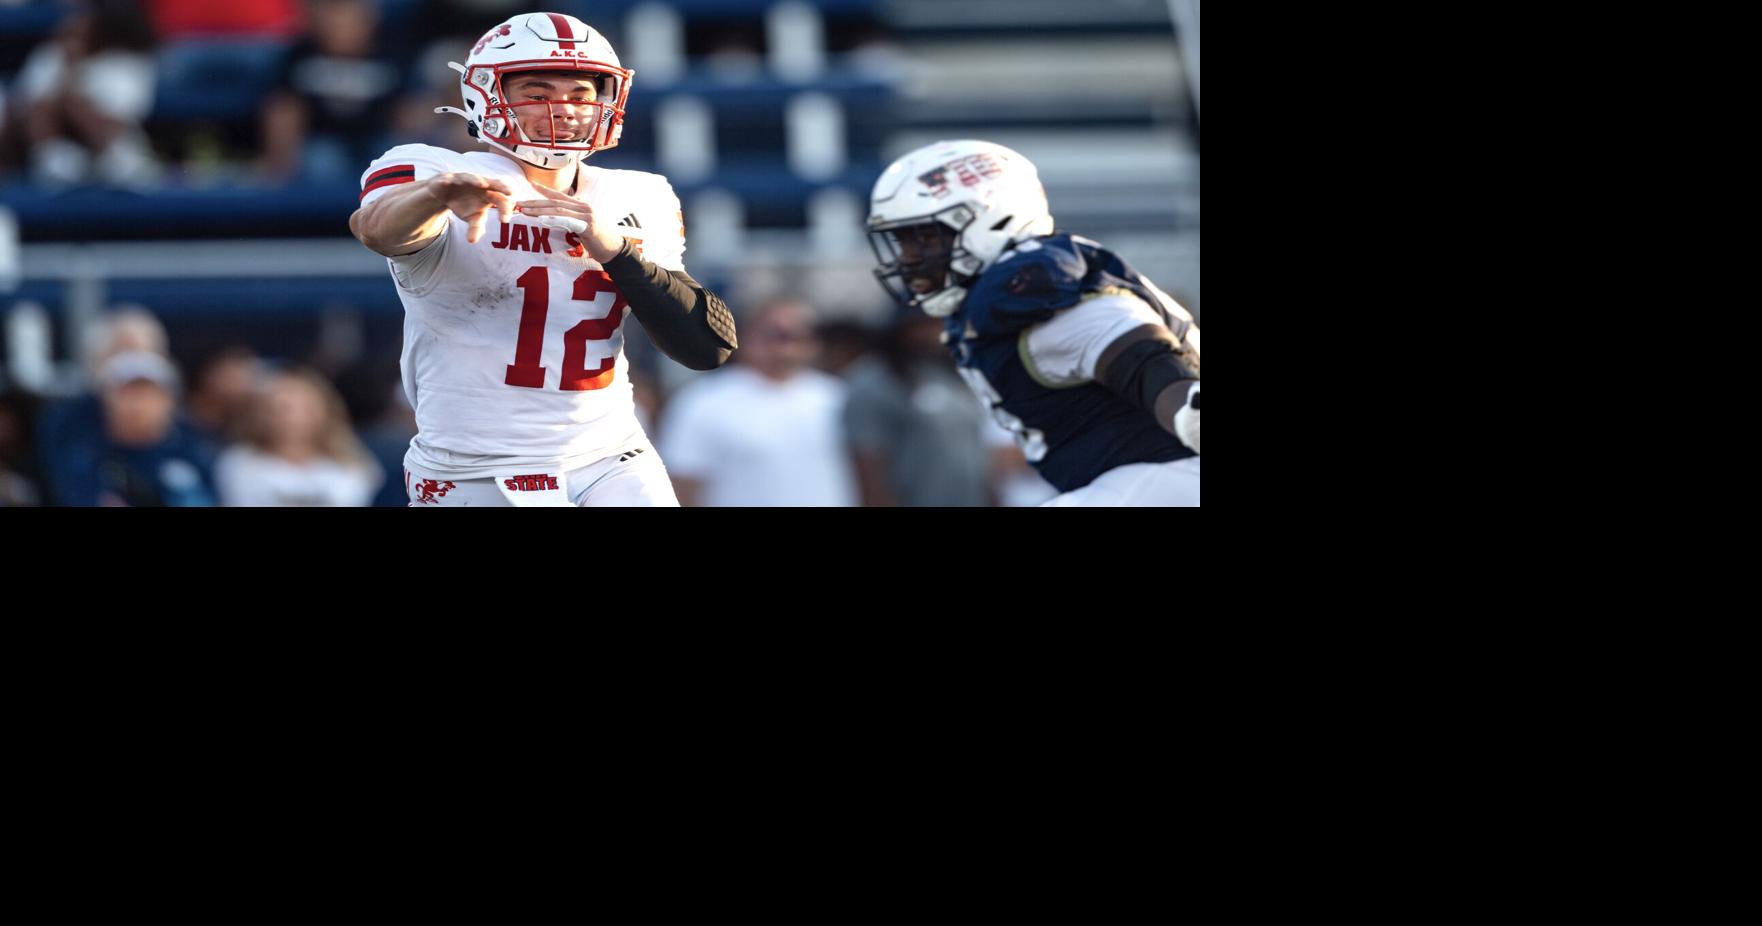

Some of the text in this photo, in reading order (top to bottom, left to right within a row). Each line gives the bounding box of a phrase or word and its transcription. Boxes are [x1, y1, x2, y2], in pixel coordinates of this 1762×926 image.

[491, 222, 552, 254] JAX
[505, 265, 628, 391] 12
[504, 476, 559, 491] STATE
